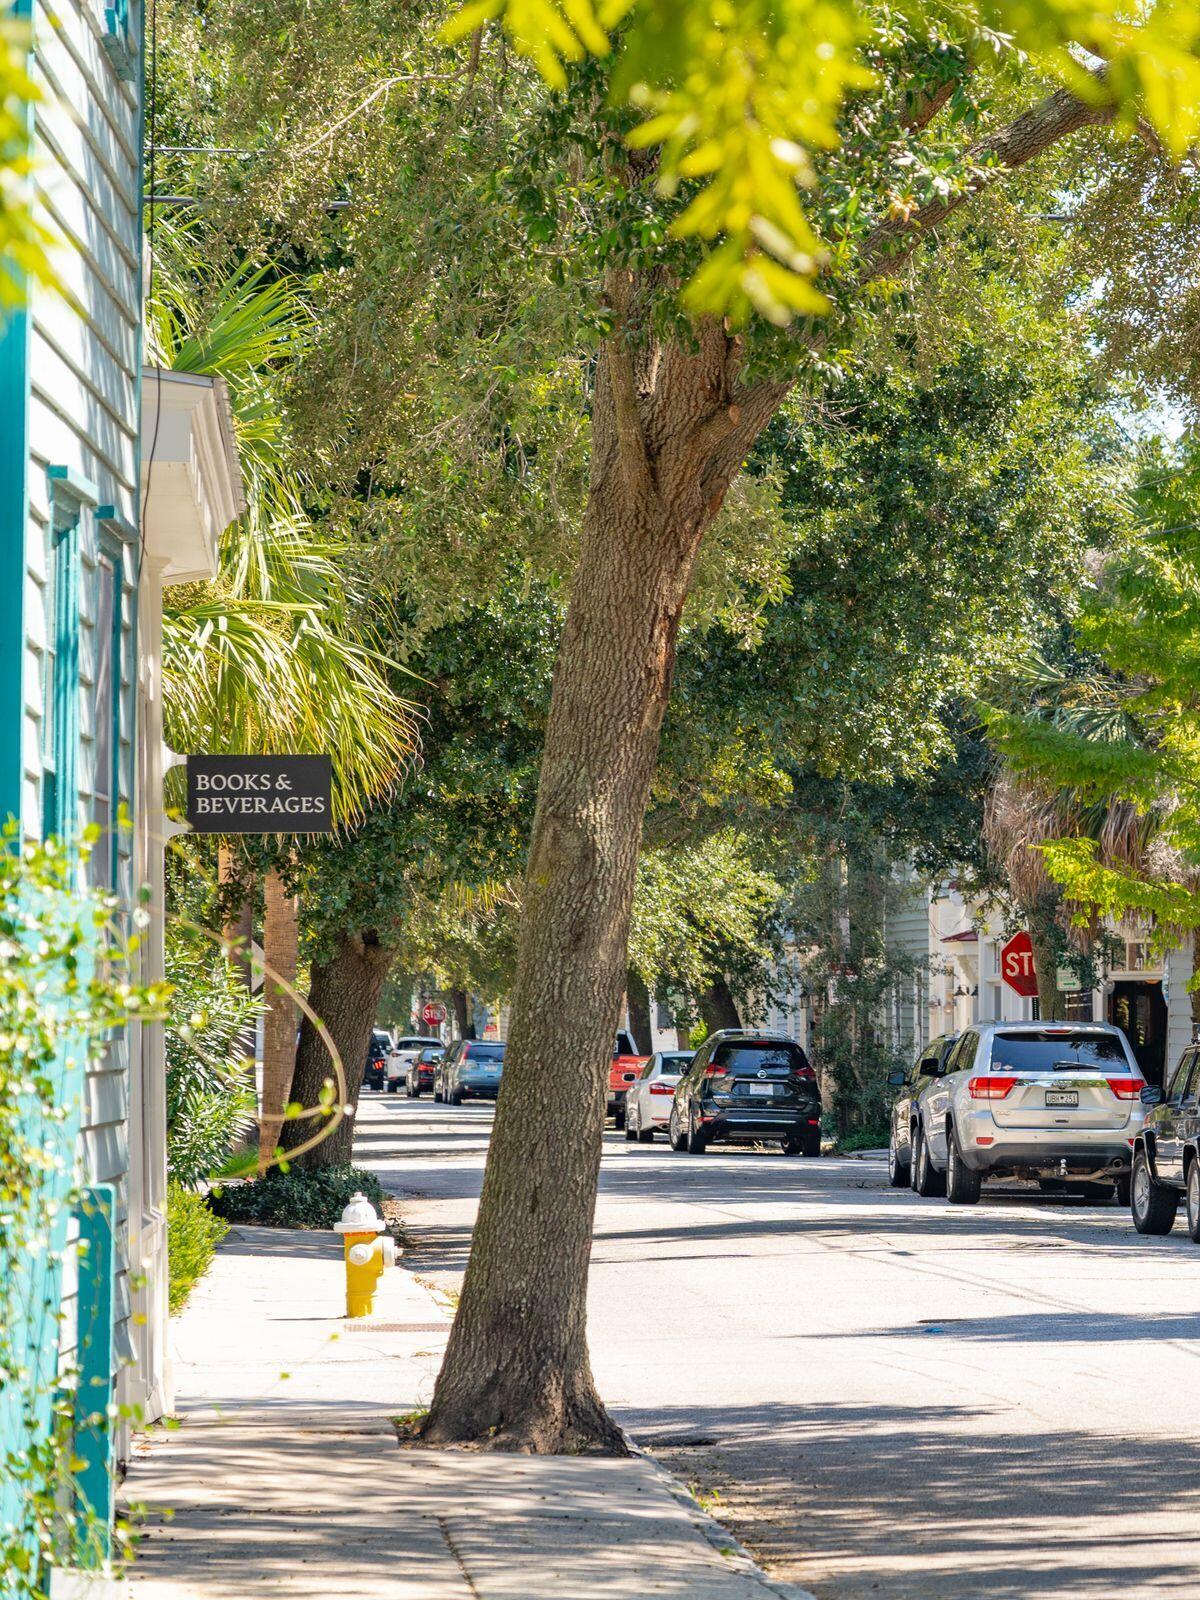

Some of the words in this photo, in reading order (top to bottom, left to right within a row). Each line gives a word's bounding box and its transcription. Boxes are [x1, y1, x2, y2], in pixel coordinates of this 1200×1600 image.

[196, 774, 271, 790] BOOKS
[275, 774, 292, 790] &
[196, 797, 325, 814] BEVERAGES
[1006, 952, 1036, 976] ST
